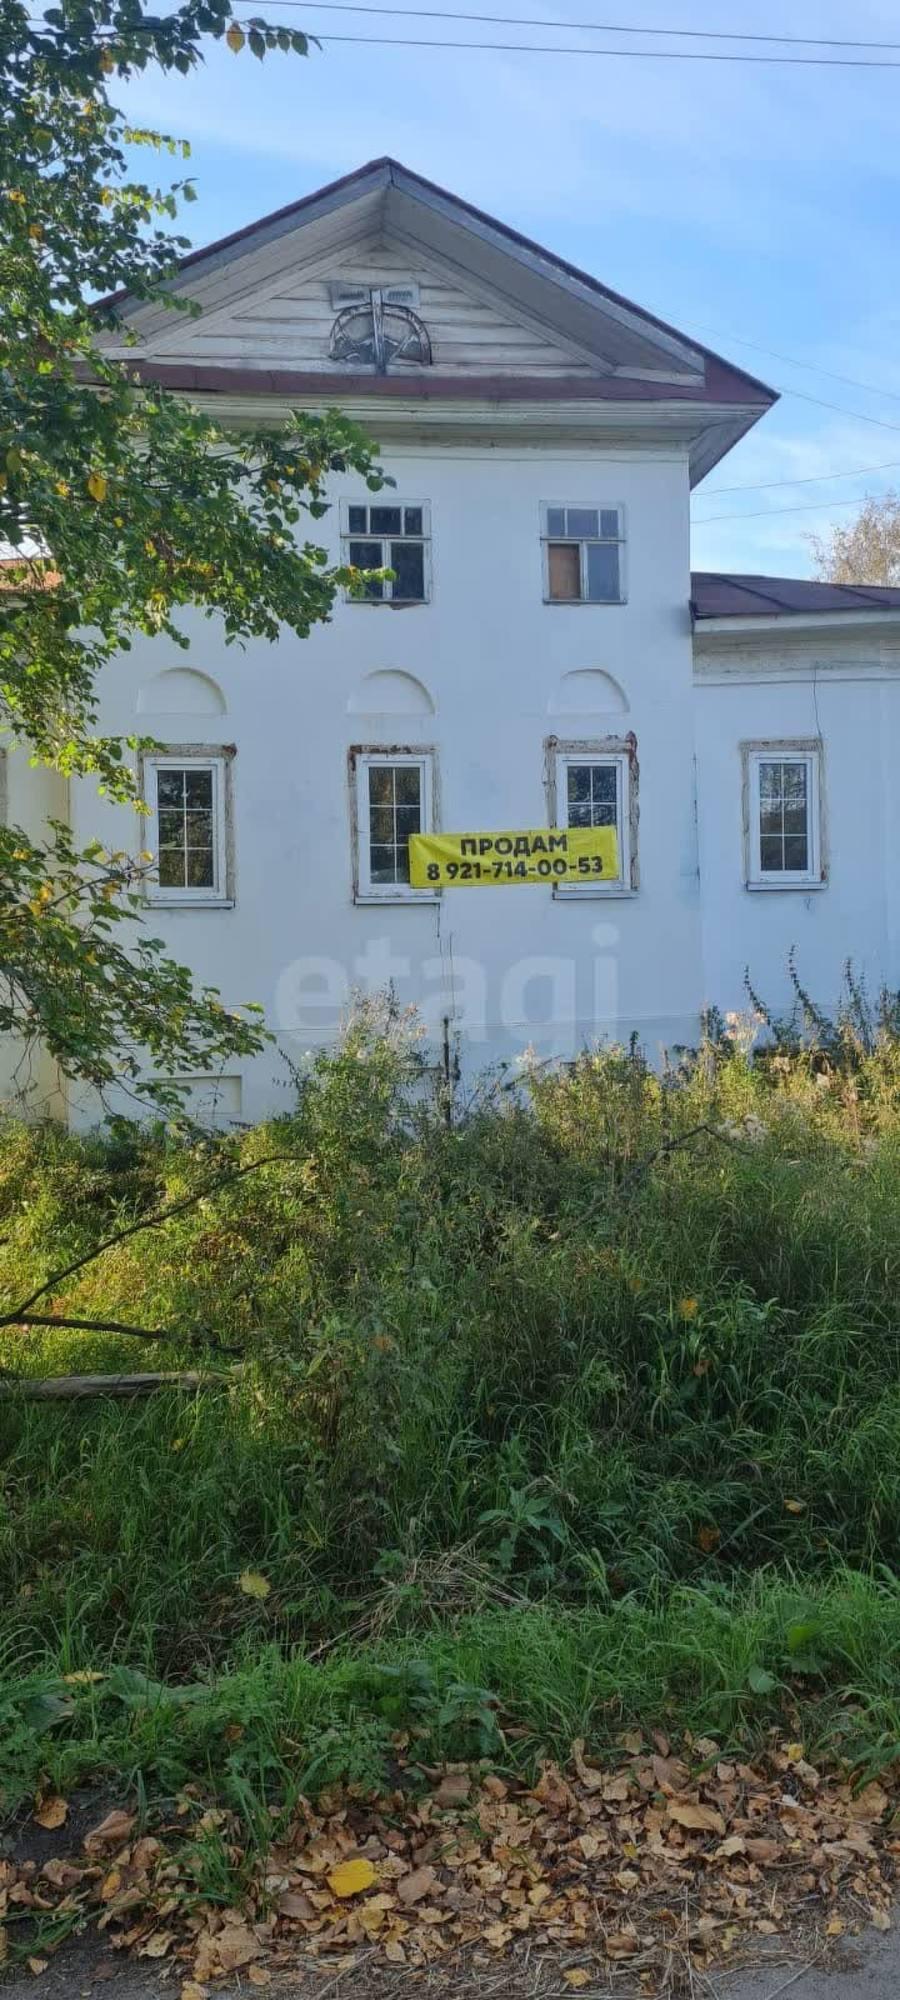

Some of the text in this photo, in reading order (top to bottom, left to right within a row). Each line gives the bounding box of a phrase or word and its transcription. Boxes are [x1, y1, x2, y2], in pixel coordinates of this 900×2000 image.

[460, 834, 568, 857] ПРОДАМ
[426, 856, 604, 881] 8 921-714-00-53
